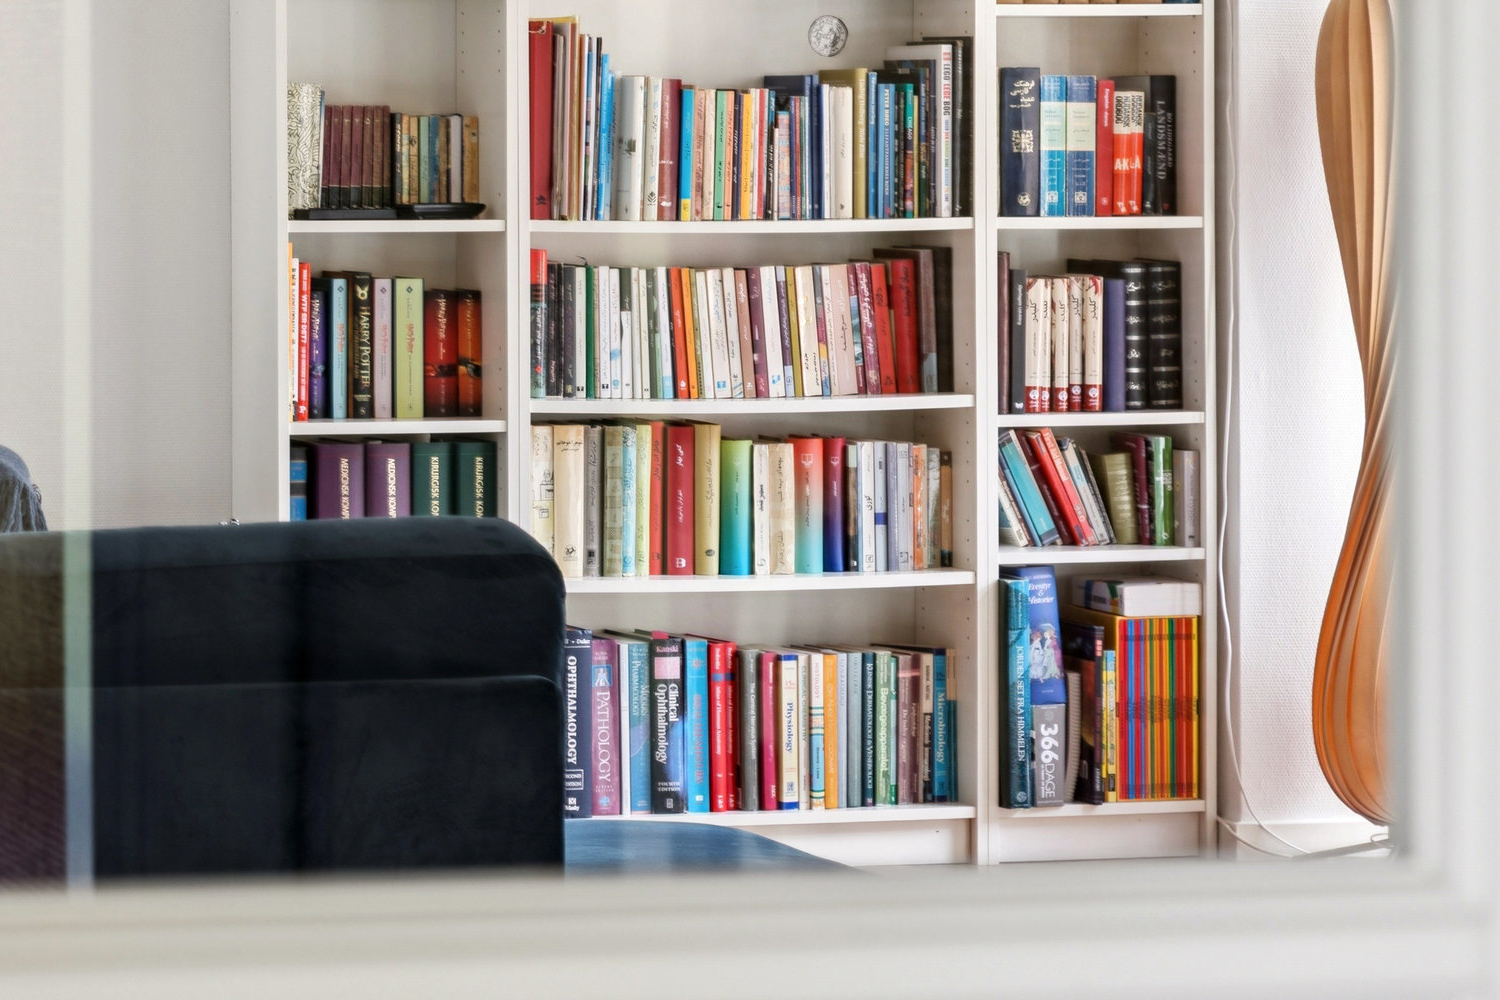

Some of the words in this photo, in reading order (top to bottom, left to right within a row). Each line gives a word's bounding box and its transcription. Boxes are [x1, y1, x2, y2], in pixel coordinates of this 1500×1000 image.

[943, 63, 952, 80] LEGO
[943, 83, 952, 99] LEGE
[943, 100, 952, 116] BOG
[1115, 96, 1123, 124] ORDBOG
[1157, 100, 1166, 180] LANDSMÆND
[301, 313, 308, 323] ER
[360, 306, 370, 344] HARRY
[863, 303, 872, 328] فرشتگان
[1030, 300, 1038, 323] کلیدر
[1072, 295, 1081, 317] کلیدر
[1089, 297, 1098, 320] کلیدر
[359, 346, 370, 389] POTTER
[340, 458, 350, 496] MEDICINSK
[388, 458, 396, 496] MEDICINSK
[476, 457, 484, 498] KIRURGISK
[866, 663, 874, 690] KLINISK
[1016, 645, 1025, 678] JORDEN
[567, 656, 578, 764] OPHTHALMOLOGY
[669, 684, 679, 722] Clinical
[866, 690, 874, 738] DERMATOLOGI
[1017, 697, 1025, 714] FRA
[598, 691, 612, 782] PATHOLOGY
[654, 684, 668, 764] Ophthalmology
[693, 694, 704, 784] BIOCHEMISTRY
[714, 730, 723, 755] Anatomy
[785, 702, 795, 753] Physiology
[879, 687, 889, 772] Bevægeapparatet
[936, 691, 947, 763] Microbiology
[1017, 716, 1026, 761] HIMMELEN
[1040, 723, 1059, 763] 366
[866, 745, 874, 789] VENEROLOGI
[1045, 763, 1056, 798] DAGE
